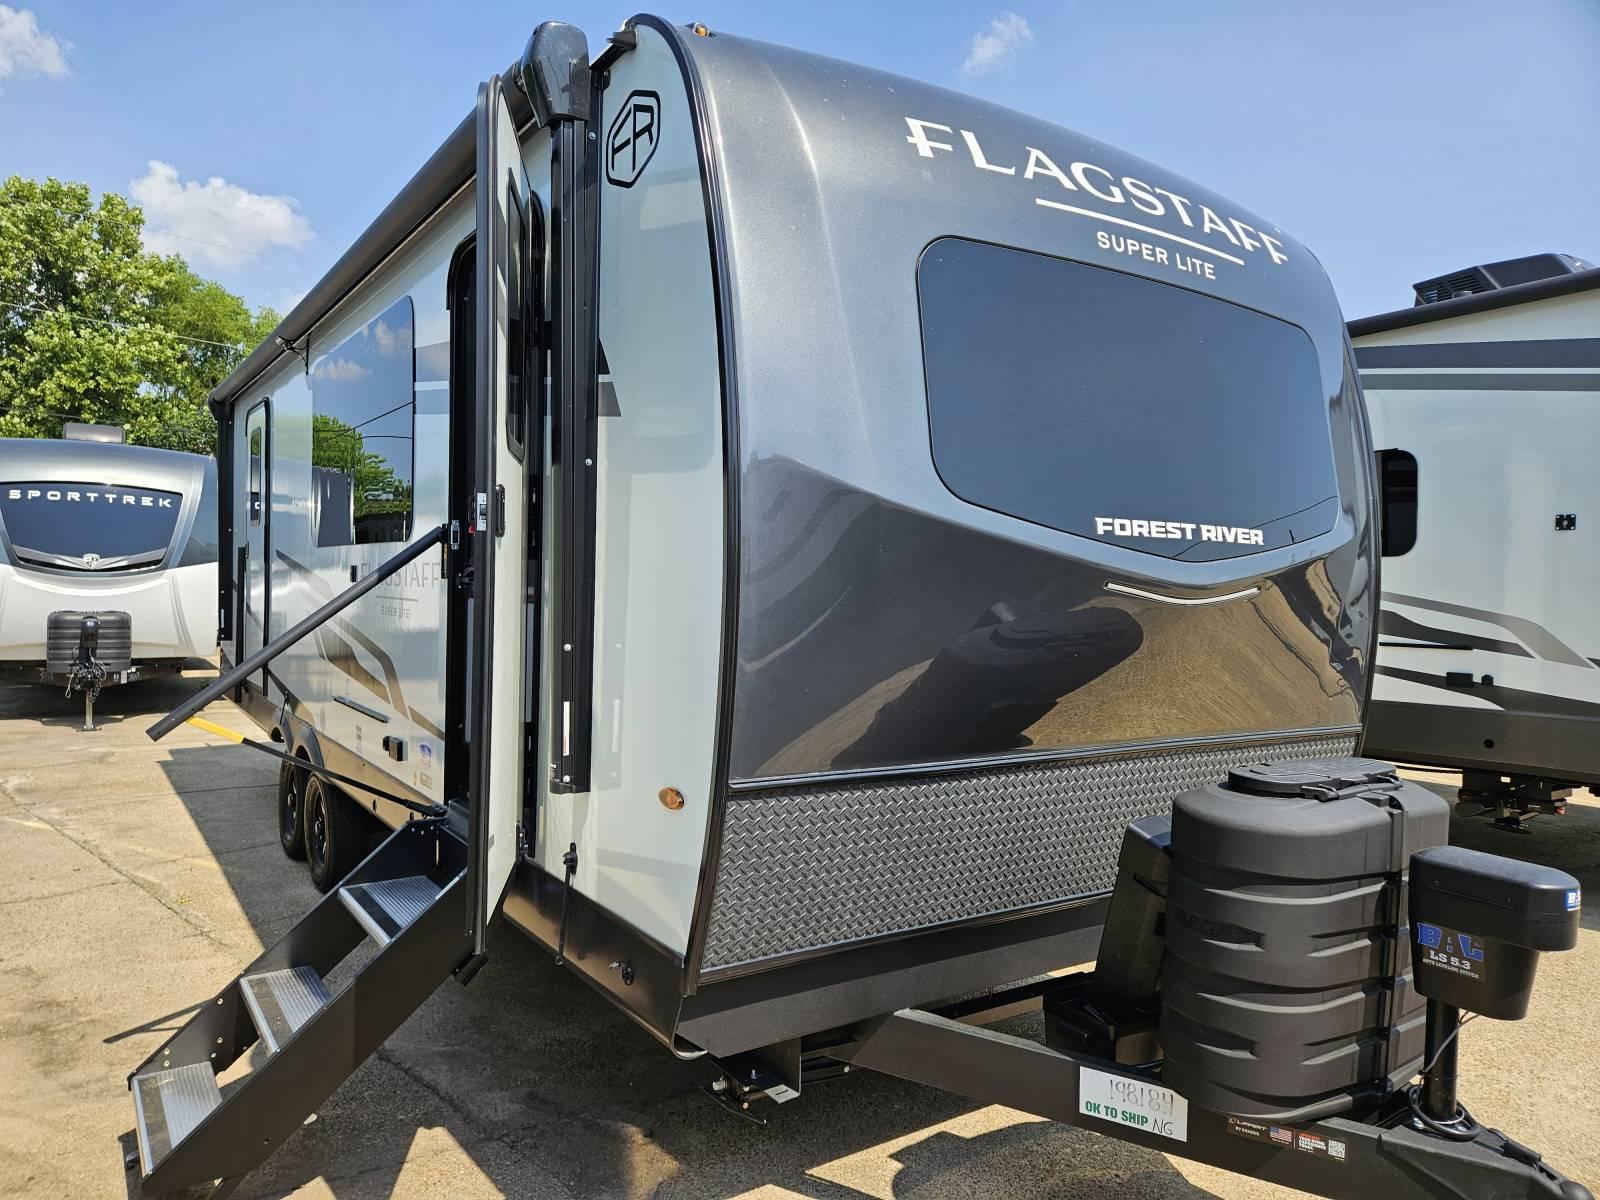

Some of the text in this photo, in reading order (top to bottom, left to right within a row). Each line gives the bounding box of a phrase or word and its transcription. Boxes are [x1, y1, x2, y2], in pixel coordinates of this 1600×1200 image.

[904, 116, 1289, 265] FLAGSTAFF
[1097, 231, 1217, 280] SUPER LITE
[8, 489, 173, 508] SPORTTREK
[1094, 517, 1265, 546] FOREST RIVER
[1430, 949, 1448, 963] LS
[1109, 1079, 1174, 1116] 198184
[1085, 1100, 1149, 1126] OK TO SHIP
[1152, 1117, 1174, 1135] NG
